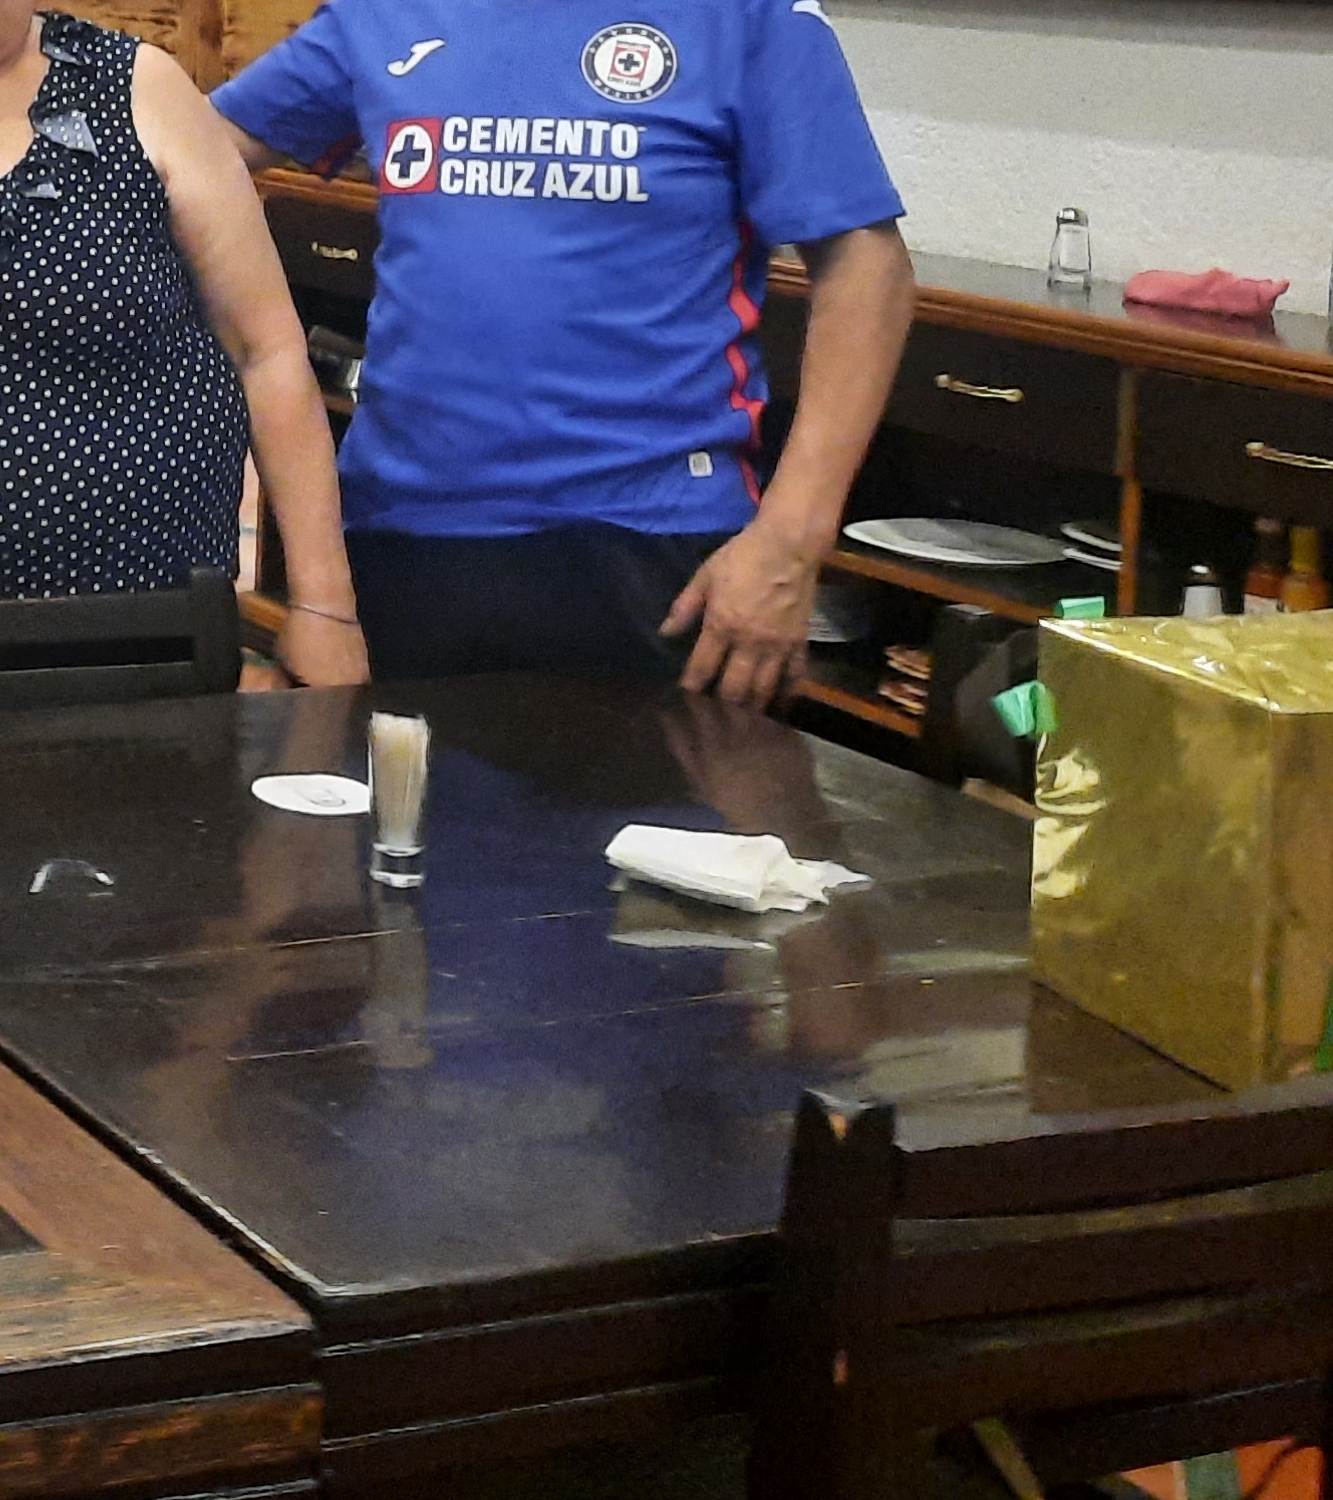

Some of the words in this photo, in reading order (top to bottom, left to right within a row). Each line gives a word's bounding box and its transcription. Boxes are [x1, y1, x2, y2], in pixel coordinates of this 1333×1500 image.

[442, 115, 639, 159] CEMENTO
[439, 158, 536, 198] CRUZ
[542, 161, 649, 203] AZUL
